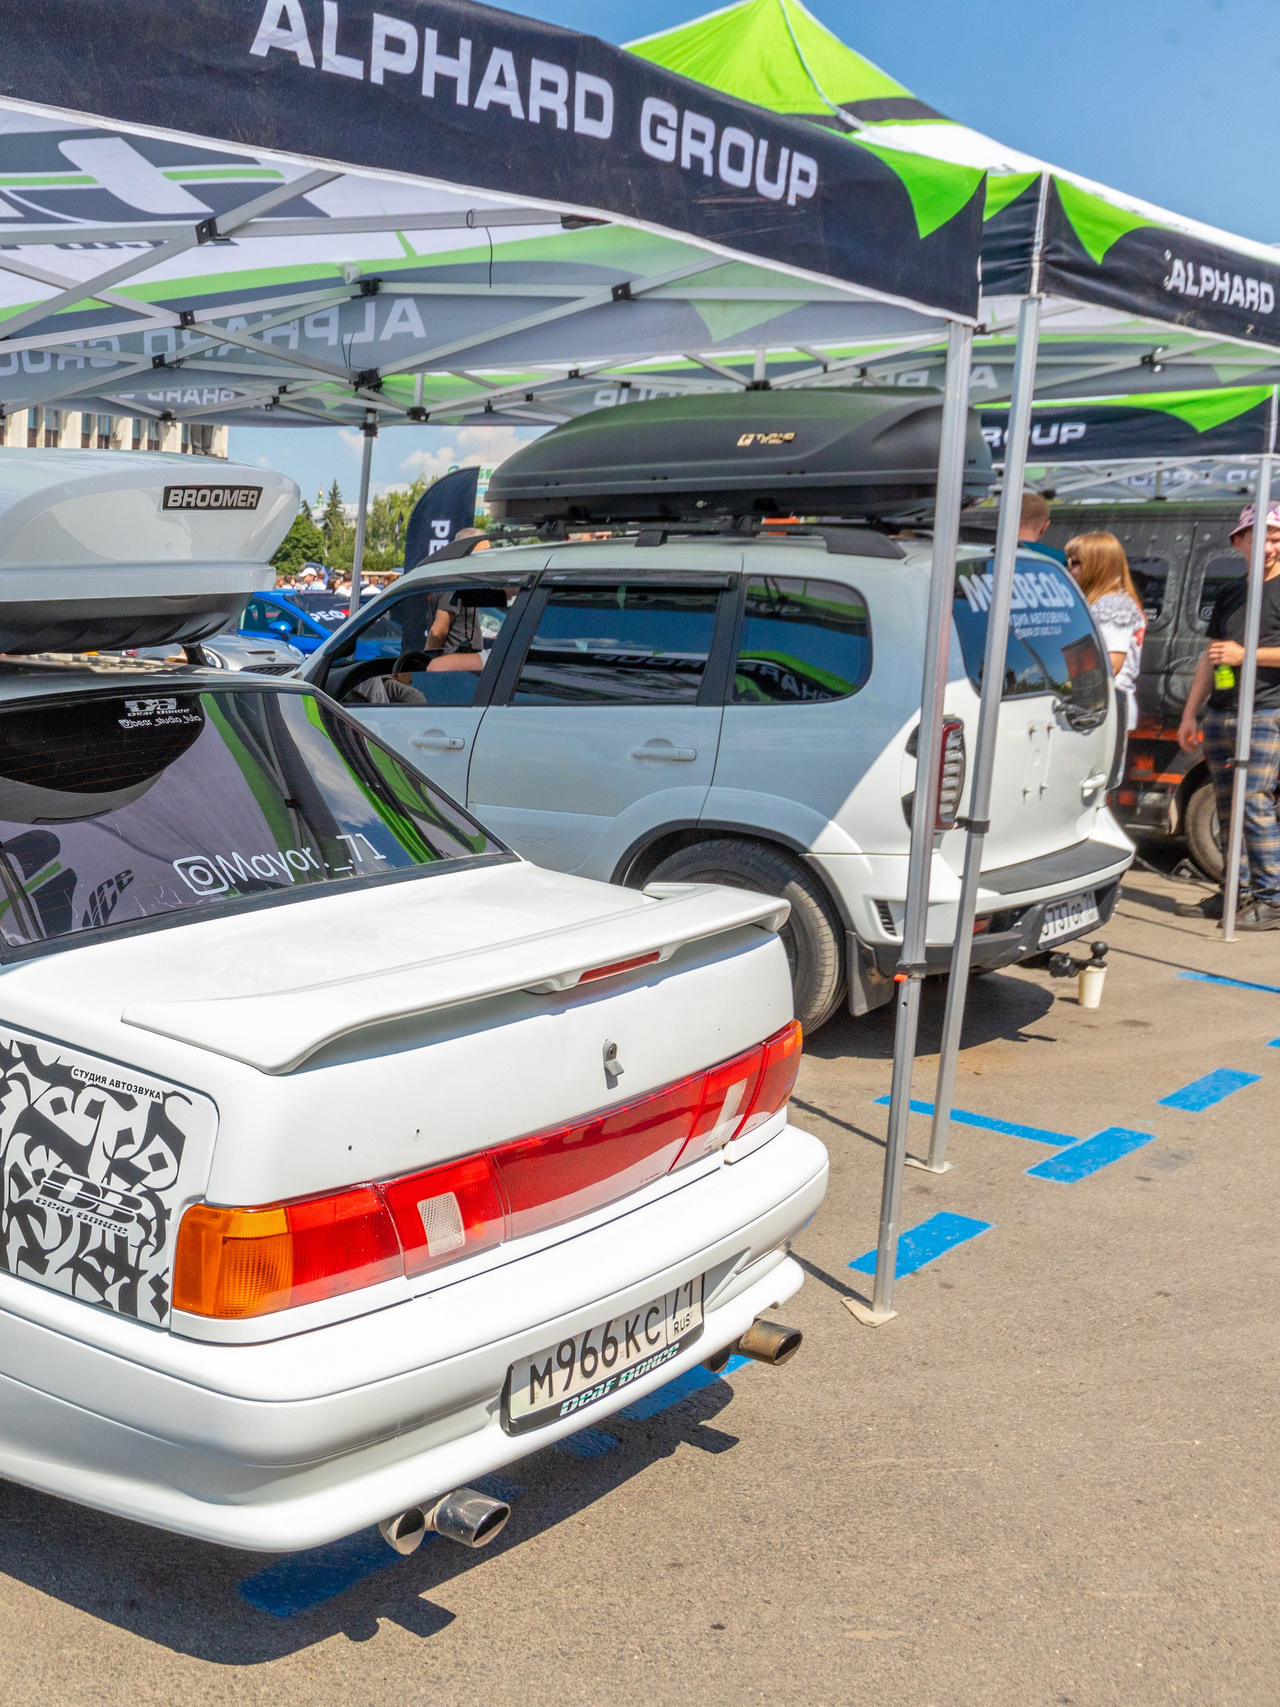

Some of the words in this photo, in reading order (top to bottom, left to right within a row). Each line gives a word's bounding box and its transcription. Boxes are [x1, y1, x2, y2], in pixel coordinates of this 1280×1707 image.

[250, 0, 614, 139] ALPHARD
[640, 97, 818, 205] GROUP
[1165, 258, 1275, 314] ALPHARD
[980, 421, 1087, 448] RUP
[167, 488, 259, 508] BROOMER
[73, 1068, 107, 1085] СТУДИЯ
[108, 1078, 162, 1100] АВТОЗВУКА
[673, 1312, 691, 1336] RUS
